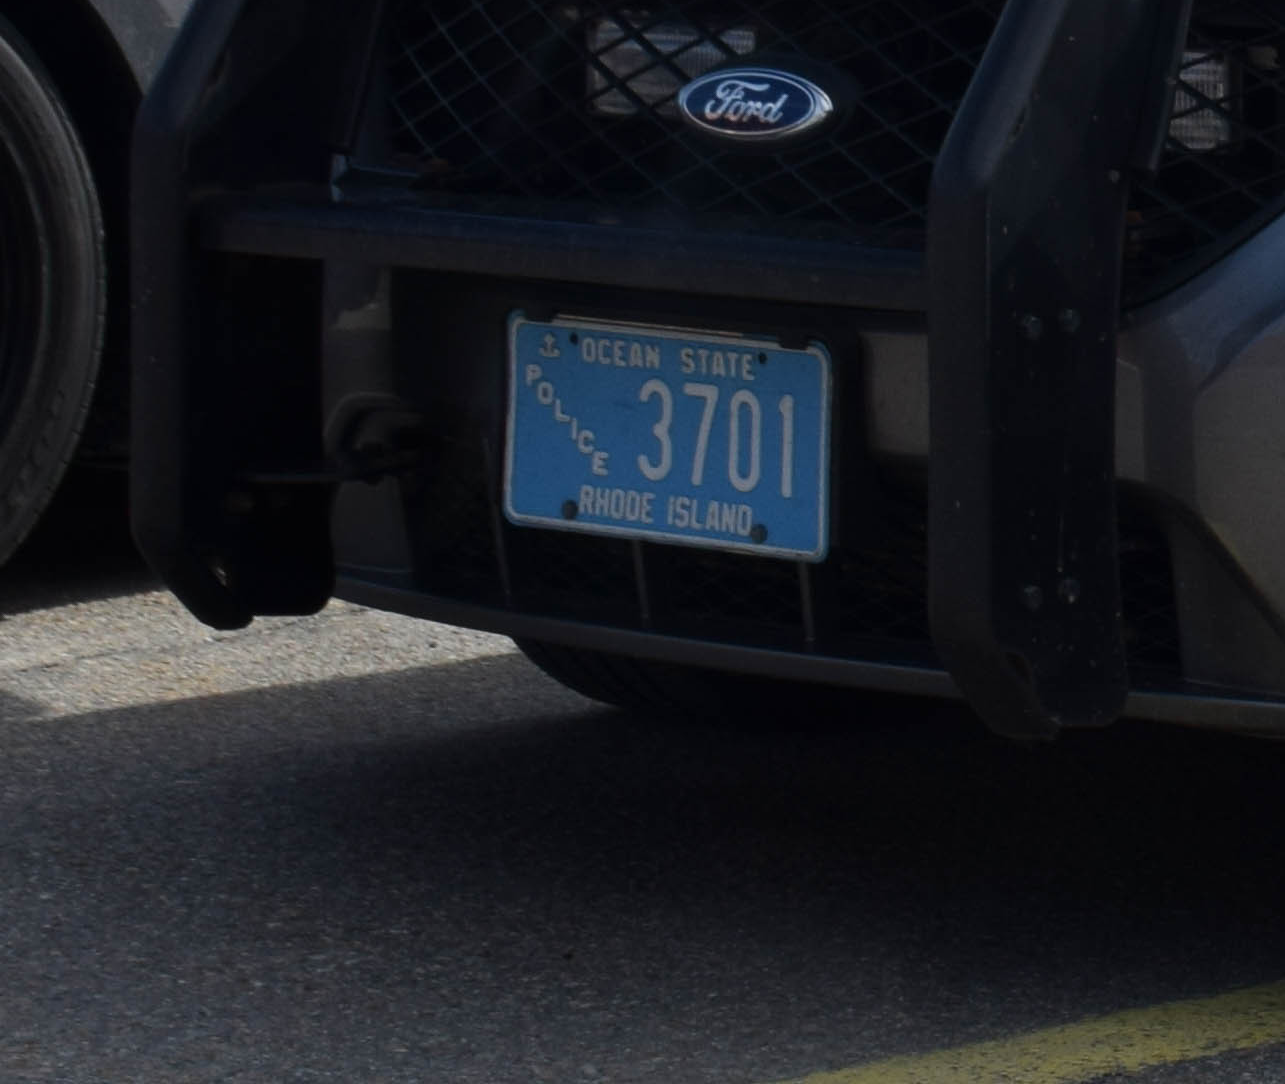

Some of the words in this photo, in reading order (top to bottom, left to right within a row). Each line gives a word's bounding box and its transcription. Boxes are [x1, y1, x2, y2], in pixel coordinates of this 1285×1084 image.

[705, 80, 787, 123] Ford
[581, 337, 661, 369] OCEAN
[681, 348, 755, 381] STATE
[525, 365, 609, 476] POLICE
[637, 379, 794, 498] 3701
[579, 486, 655, 524] RHODE
[667, 496, 753, 537] ISLAND
